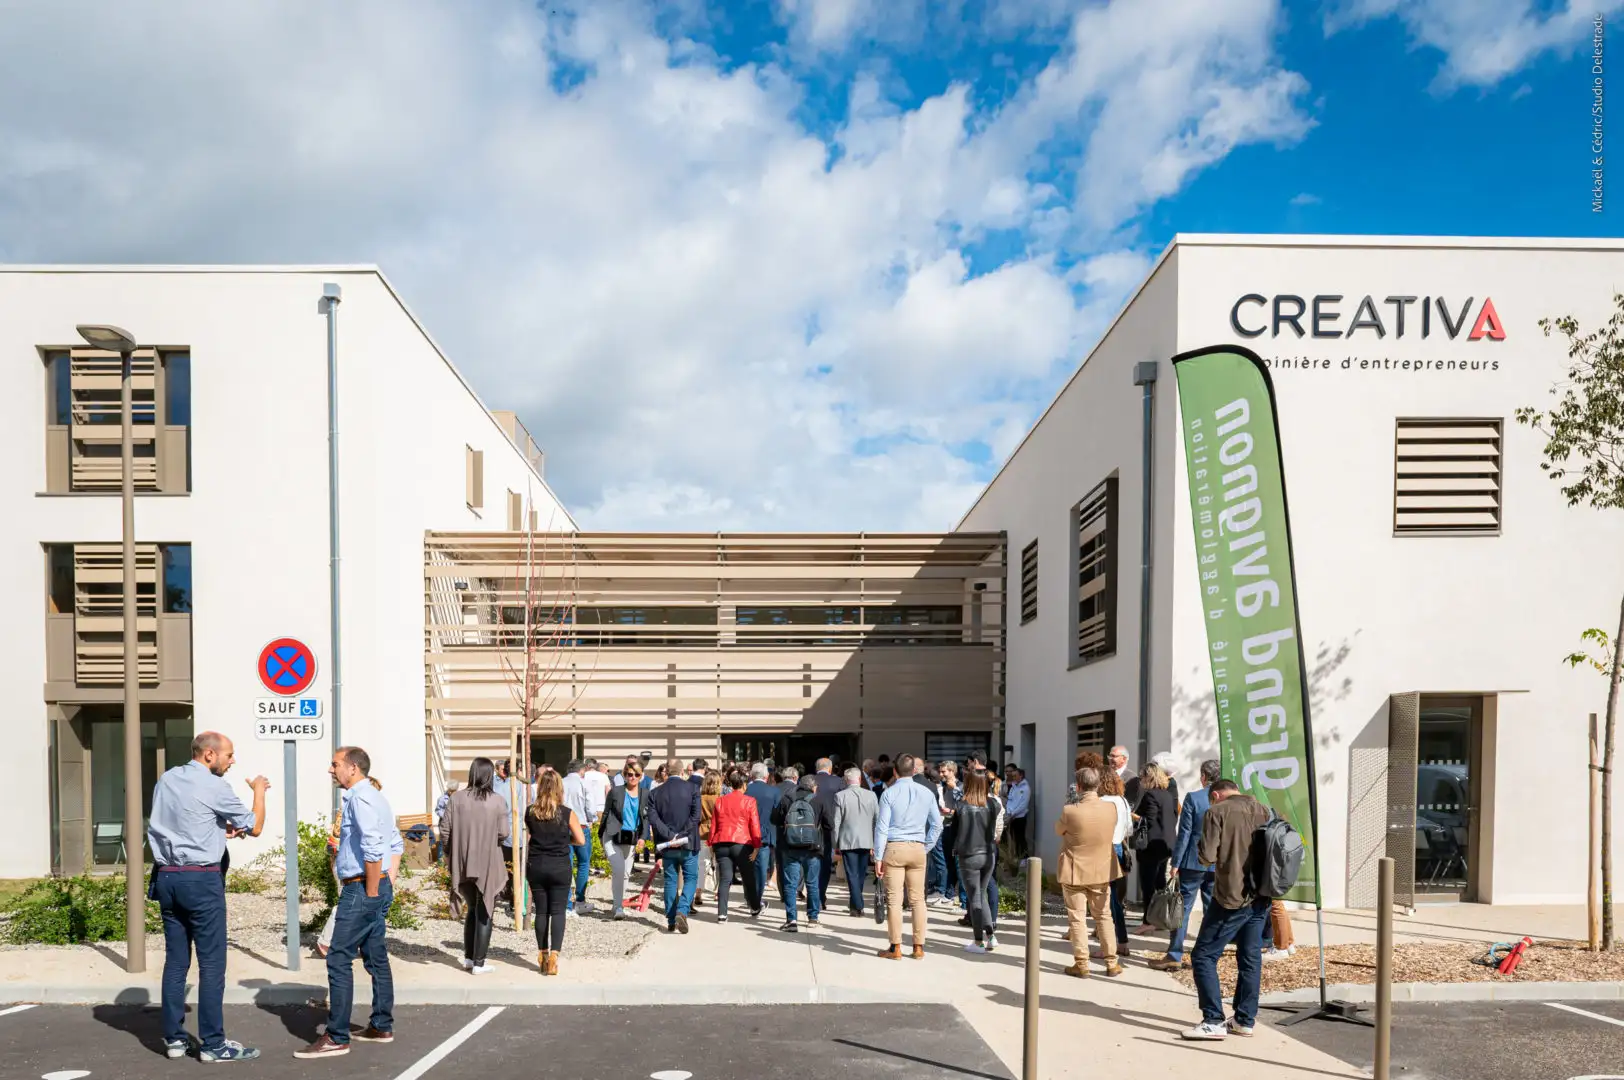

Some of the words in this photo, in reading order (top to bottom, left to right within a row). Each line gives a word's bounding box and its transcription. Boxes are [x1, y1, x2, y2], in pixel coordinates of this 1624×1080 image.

[1230, 293, 1507, 341] CREATIVA
[259, 702, 295, 713] SAUF
[259, 724, 266, 734] 3
[270, 724, 318, 734] PLACES
